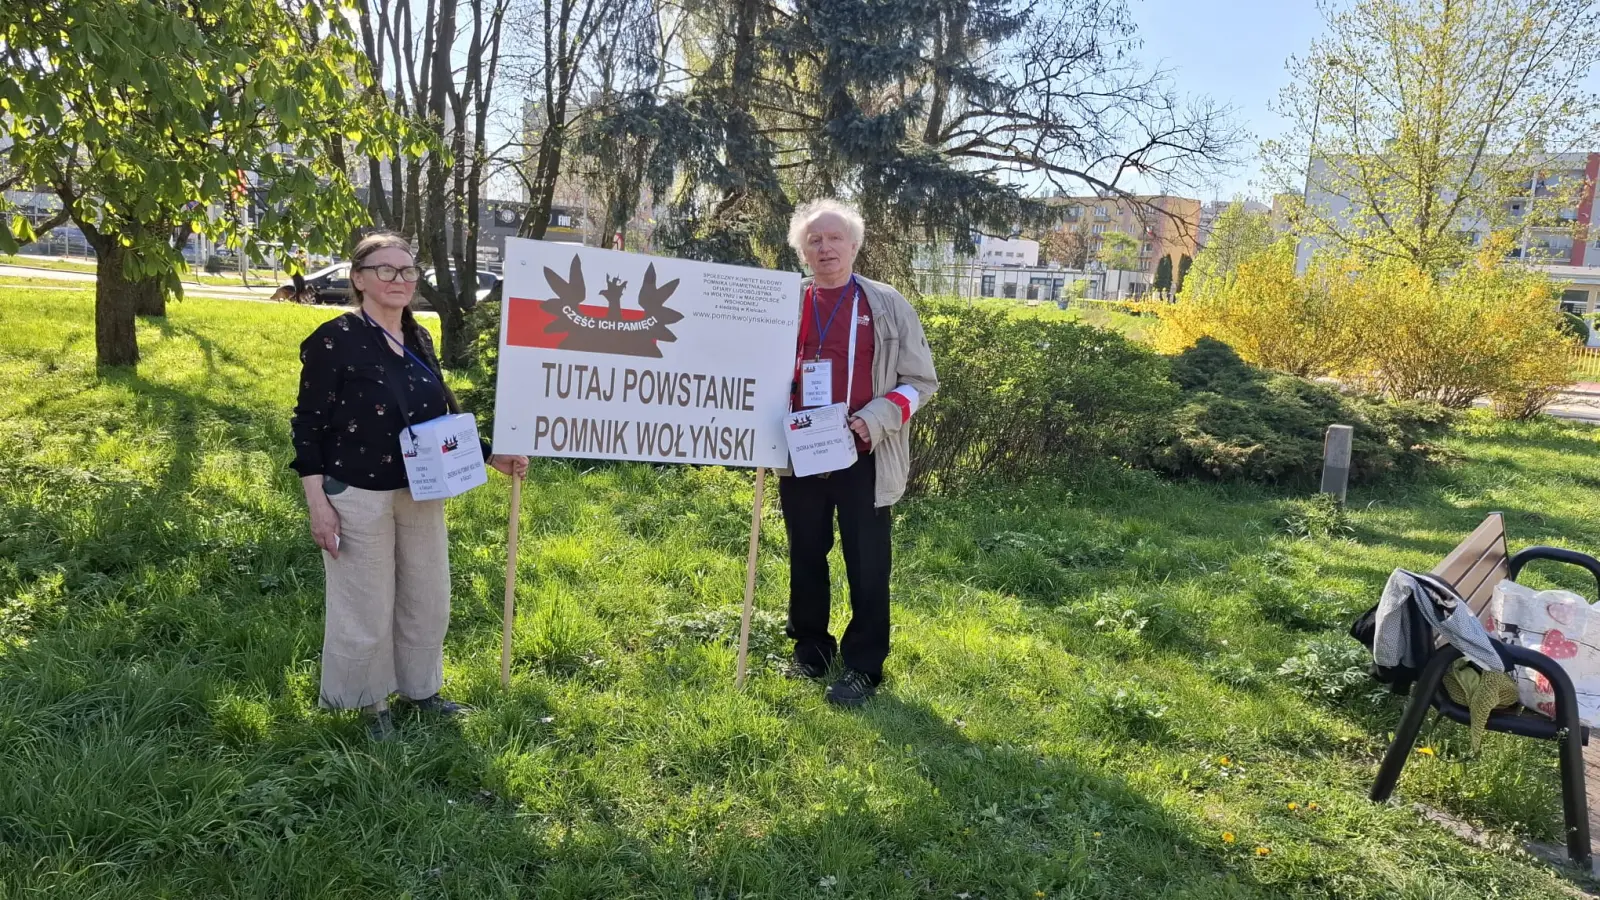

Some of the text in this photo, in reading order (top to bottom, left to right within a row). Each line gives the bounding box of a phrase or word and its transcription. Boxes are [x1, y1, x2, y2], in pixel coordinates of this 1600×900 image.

[562, 305, 658, 331] CZEŚĆ ICH PAMIĘCI
[724, 299, 759, 307] WSCHODNIEJ
[541, 362, 616, 402] TUTAJ
[622, 368, 756, 411] POWSTANIE
[533, 415, 755, 461] POMNIK WOŁYŃSKI
